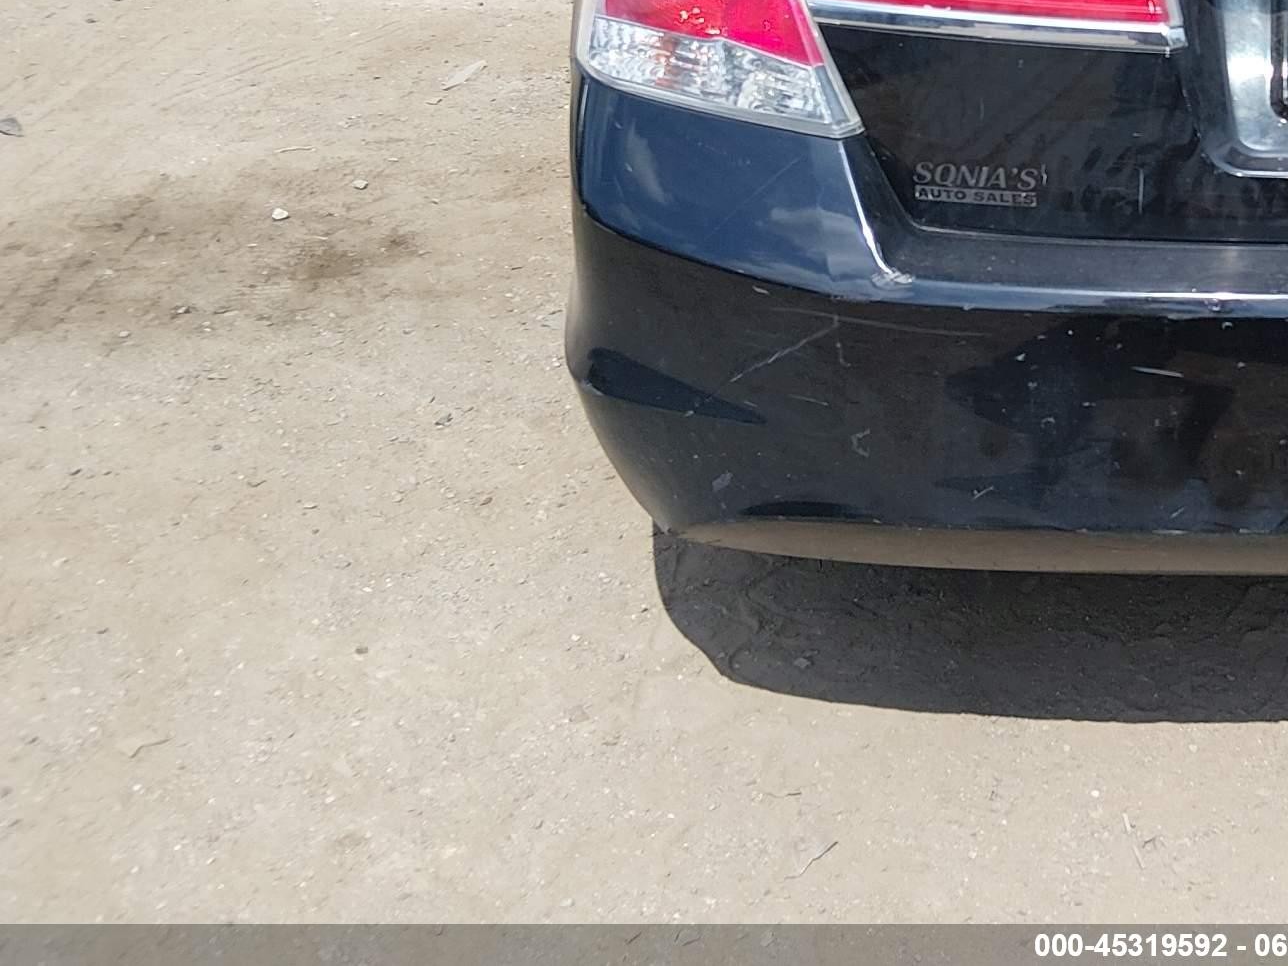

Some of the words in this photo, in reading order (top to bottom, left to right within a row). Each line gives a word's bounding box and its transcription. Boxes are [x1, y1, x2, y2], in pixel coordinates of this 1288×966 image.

[912, 161, 1040, 191] SONIA'S
[917, 187, 967, 201] AUTO
[973, 190, 1036, 206] SALES
